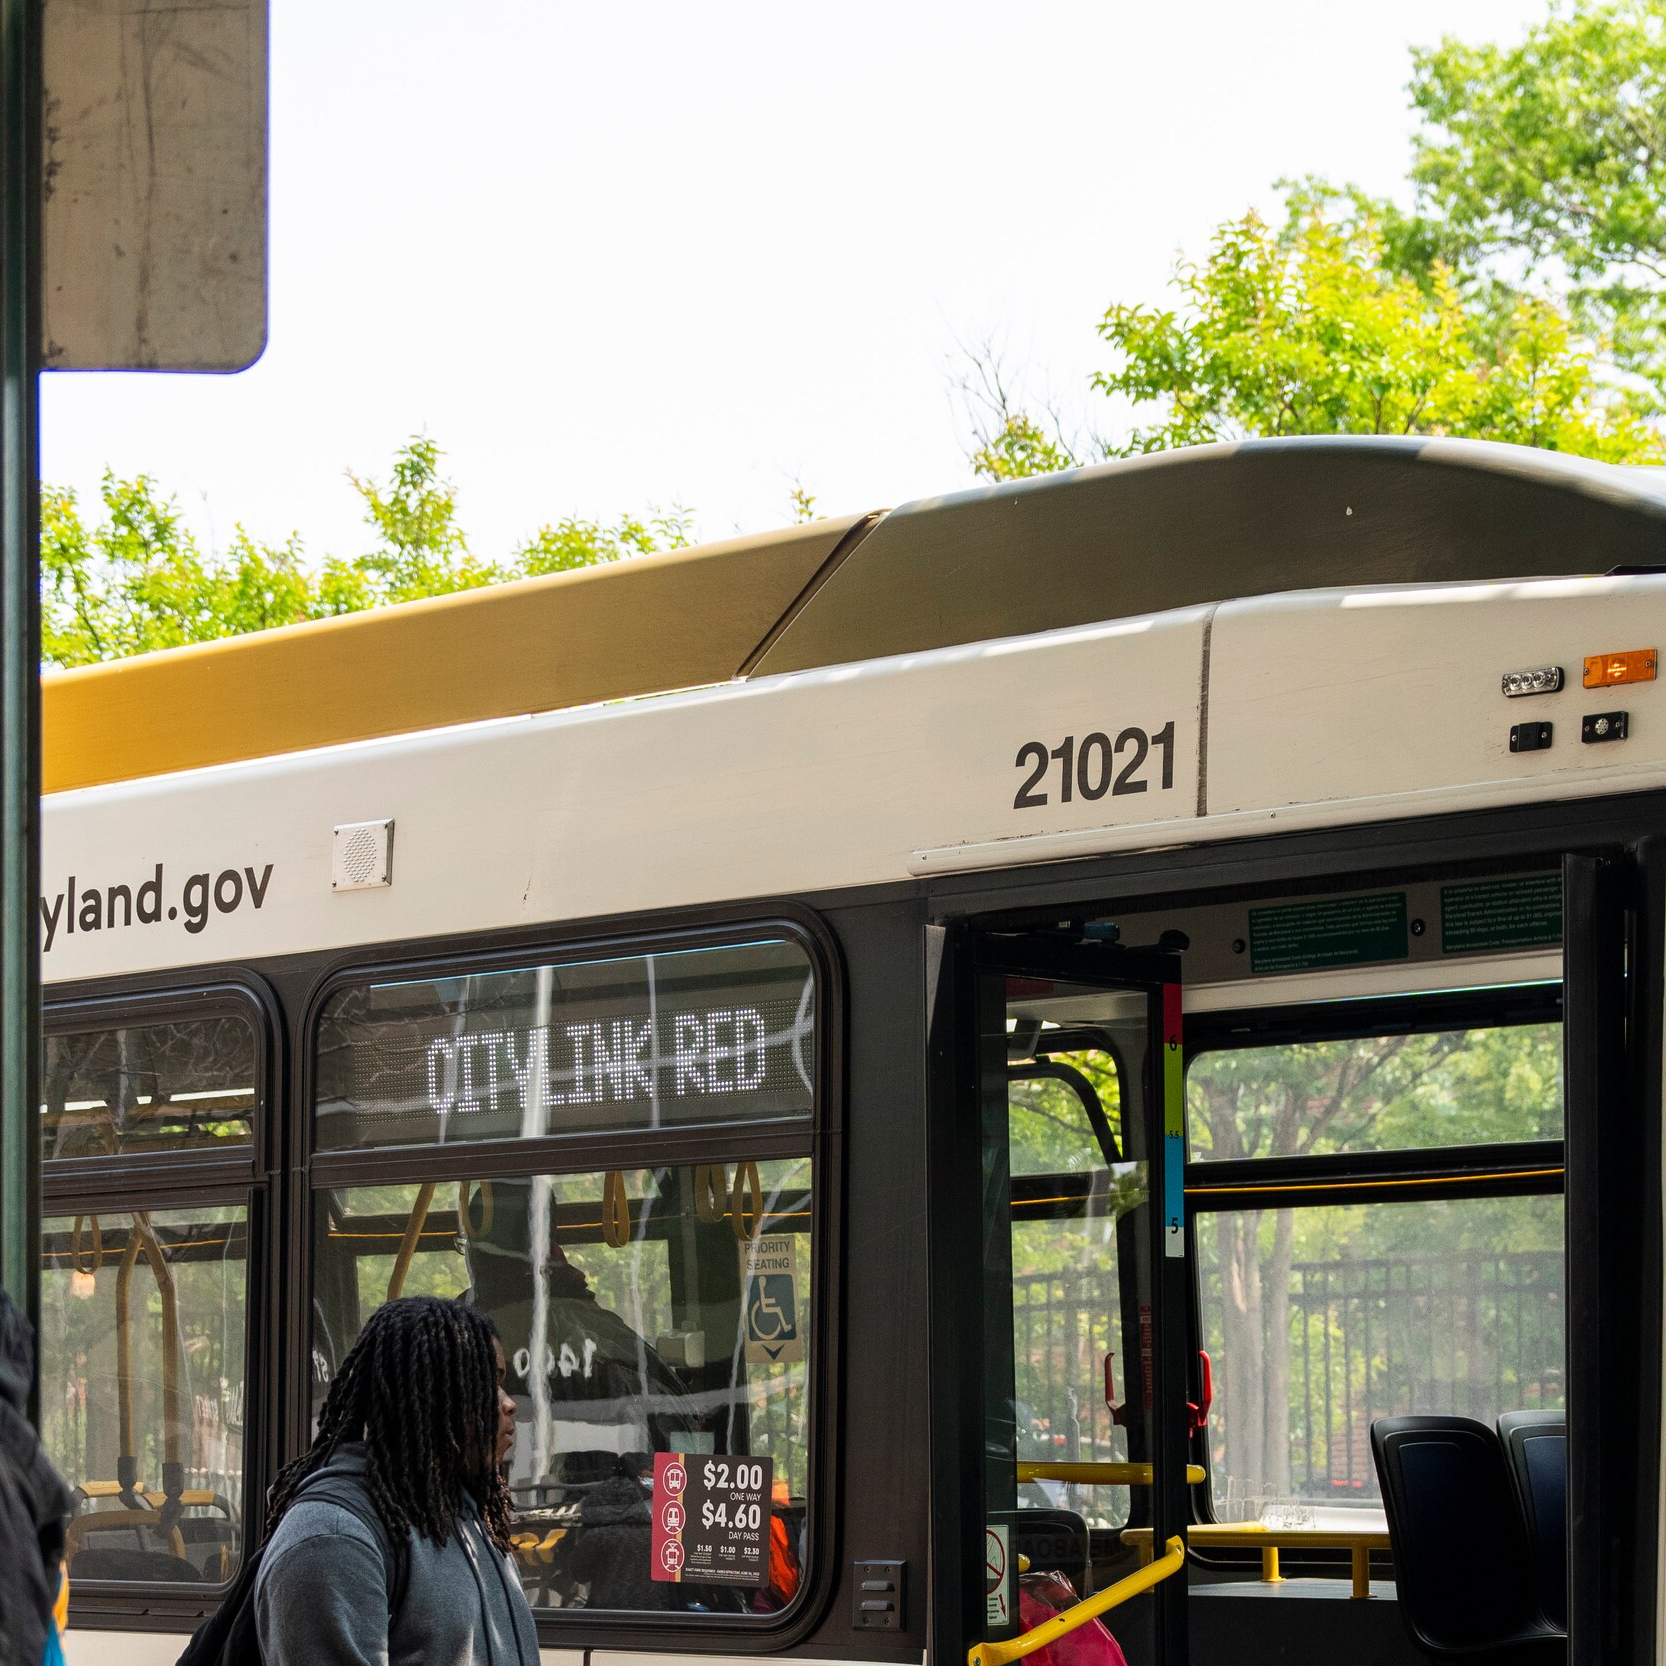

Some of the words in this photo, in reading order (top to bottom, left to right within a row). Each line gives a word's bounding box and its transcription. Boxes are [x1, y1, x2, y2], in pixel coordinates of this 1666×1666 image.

[1013, 721, 1175, 809] 21021
[1169, 1034, 1178, 1051] 6
[676, 1009, 765, 1095] RED
[1171, 1217, 1179, 1235] 5
[744, 1241, 790, 1254] PRIORITY
[747, 1258, 790, 1270] SEATING
[703, 1460, 763, 1490] $2.00
[730, 1492, 745, 1501] ONE
[746, 1493, 762, 1502] WAY
[702, 1499, 761, 1529] $4.60
[728, 1532, 742, 1540] DAY
[743, 1532, 760, 1541] PASS
[720, 1545, 736, 1553] $1.00
